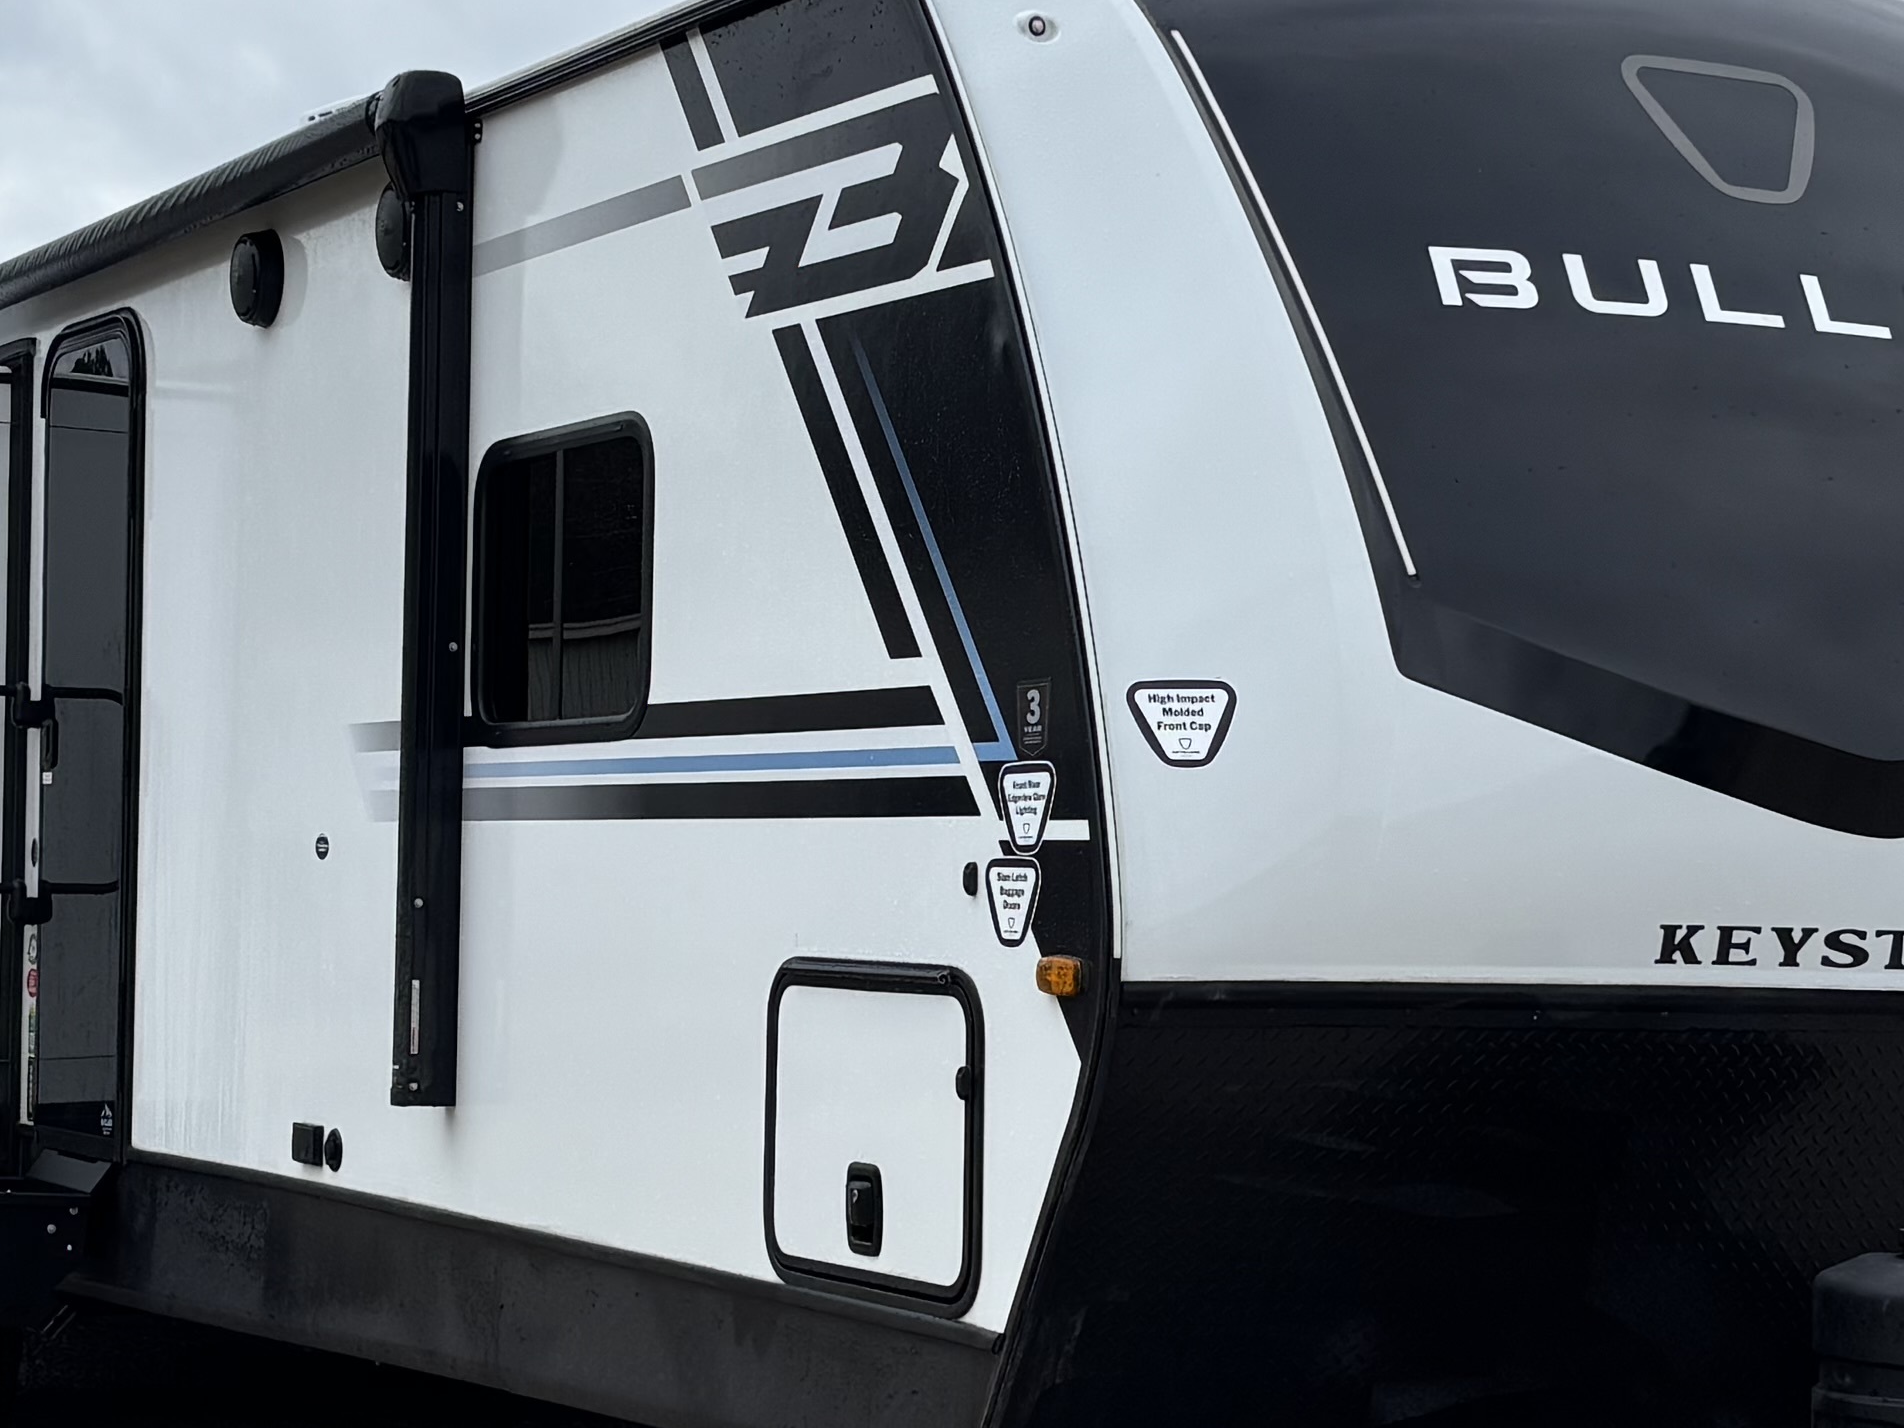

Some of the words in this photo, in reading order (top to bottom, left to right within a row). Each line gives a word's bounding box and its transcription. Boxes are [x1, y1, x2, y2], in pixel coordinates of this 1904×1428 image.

[1147, 693, 1175, 705] High
[1176, 693, 1216, 705] Impact
[1026, 689, 1041, 724] 3
[1161, 706, 1205, 717] Molded
[1023, 724, 1043, 734] YEAR
[1156, 720, 1188, 731] Front
[1189, 720, 1212, 732] Cap
